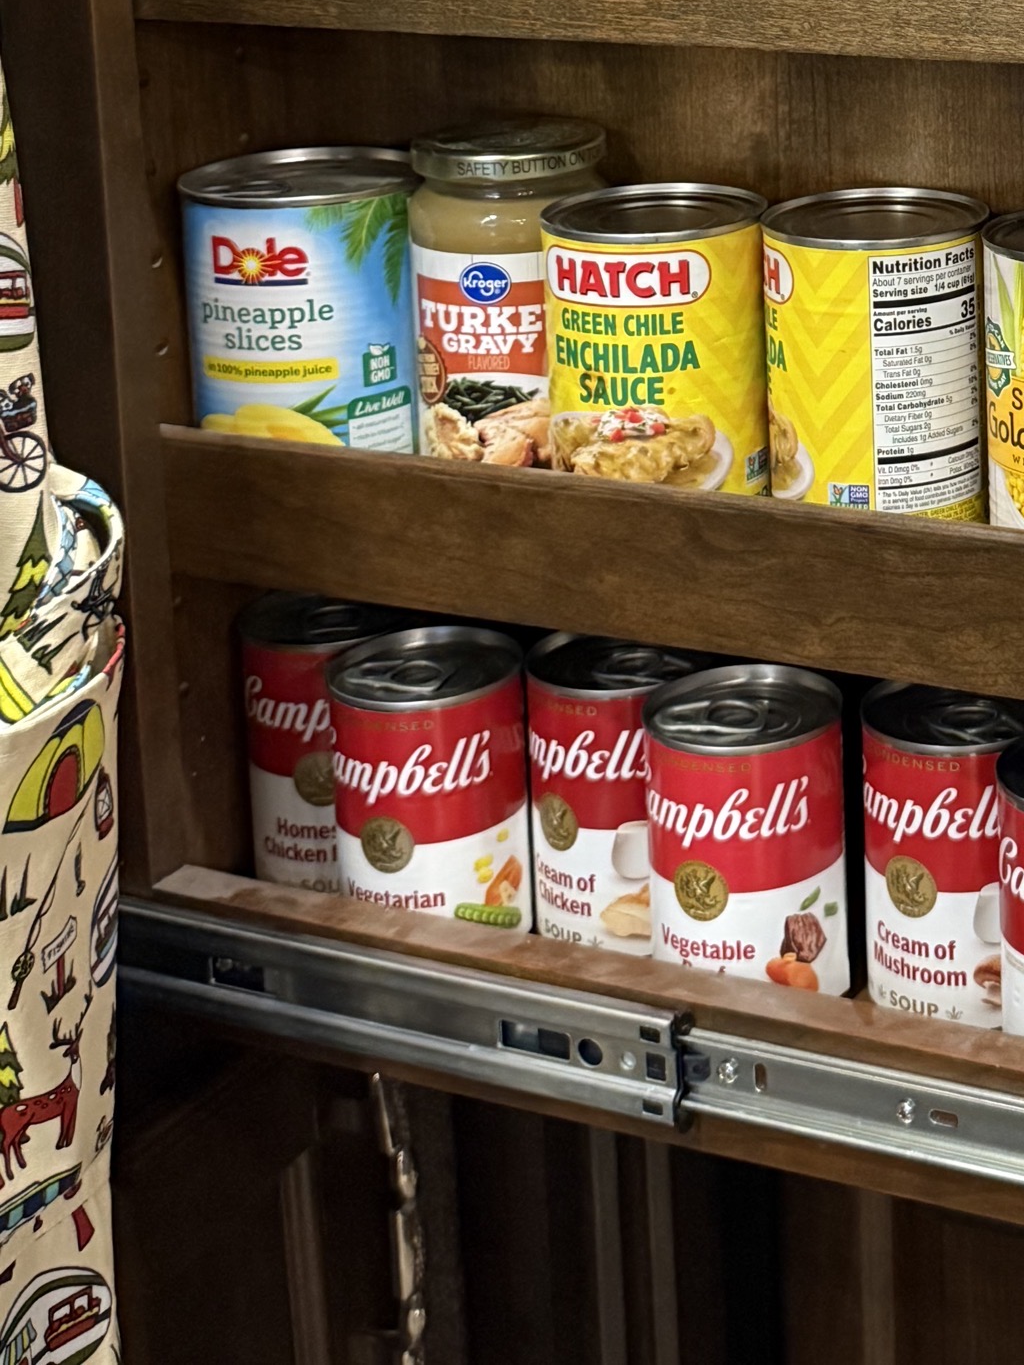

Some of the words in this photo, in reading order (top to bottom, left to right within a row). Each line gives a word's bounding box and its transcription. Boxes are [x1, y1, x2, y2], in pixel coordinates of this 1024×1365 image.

[457, 160, 508, 177] SAFETY
[512, 154, 567, 176] BUTTON
[569, 152, 585, 168] ON
[211, 235, 310, 284] Dole
[872, 255, 942, 275] Nutrition
[945, 247, 975, 266] Facts
[463, 270, 508, 297] Kroger
[555, 254, 692, 299] HATCH
[202, 298, 335, 330] pineapple
[420, 297, 547, 335] TURKE
[561, 307, 618, 336] GREEN
[623, 311, 685, 337] CHILE
[873, 315, 932, 333] Calories
[224, 327, 303, 352] slices
[442, 332, 539, 355] GRAVY
[369, 356, 390, 371] NON
[467, 354, 511, 373] FLAVORED
[555, 333, 701, 374] ENCHILADA
[217, 362, 242, 375] 100%
[244, 365, 301, 379] pineapple
[302, 362, 333, 377] juice
[371, 368, 391, 384] GMO
[578, 372, 665, 407] SAUCE
[354, 401, 381, 416] Live
[381, 391, 405, 410] Well
[850, 485, 868, 493] NON
[264, 835, 328, 862] Chicken
[577, 873, 597, 893] of
[538, 879, 592, 917] Chicken
[544, 918, 583, 942] SOUP
[660, 923, 756, 961] Vegetable
[877, 920, 930, 960] Cream
[934, 941, 957, 961] of
[873, 941, 968, 987] Mushroom
[890, 990, 940, 1018] SOUP
